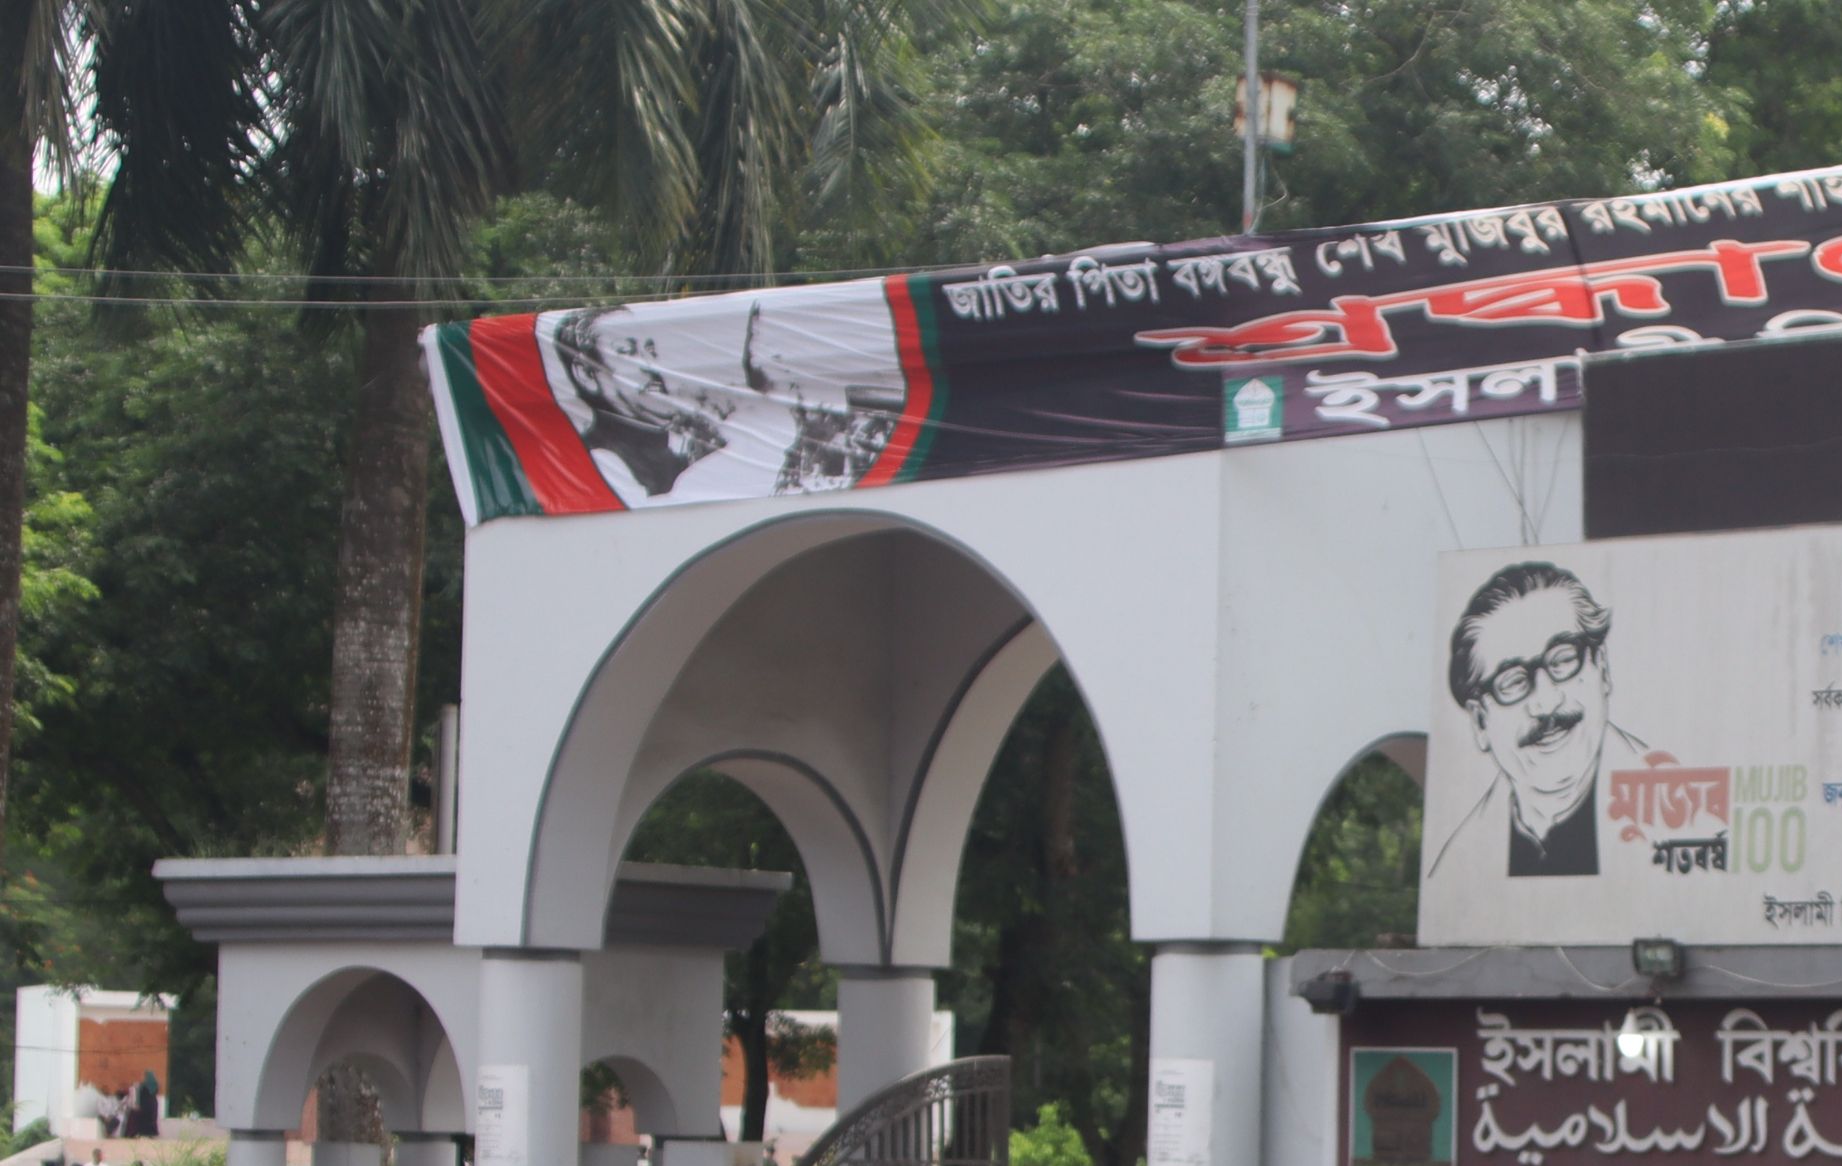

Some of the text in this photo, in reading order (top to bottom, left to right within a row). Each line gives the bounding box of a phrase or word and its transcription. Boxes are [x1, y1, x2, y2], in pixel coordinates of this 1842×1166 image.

[942, 265, 1058, 321] জাতির
[1066, 255, 1160, 308] পিতা
[1167, 246, 1303, 295] বঙ্গবন্ধু
[1315, 230, 1407, 278] শেখ
[1575, 188, 1764, 235] রহমানের
[1607, 750, 1731, 843] মুজিব
[1733, 765, 1807, 801] MUJIB
[1652, 829, 1728, 875] শতবর্ষ
[1731, 807, 1807, 874] 100
[1763, 891, 1834, 929] ইসলামী
[1476, 1007, 1681, 1086] ইসলামী
